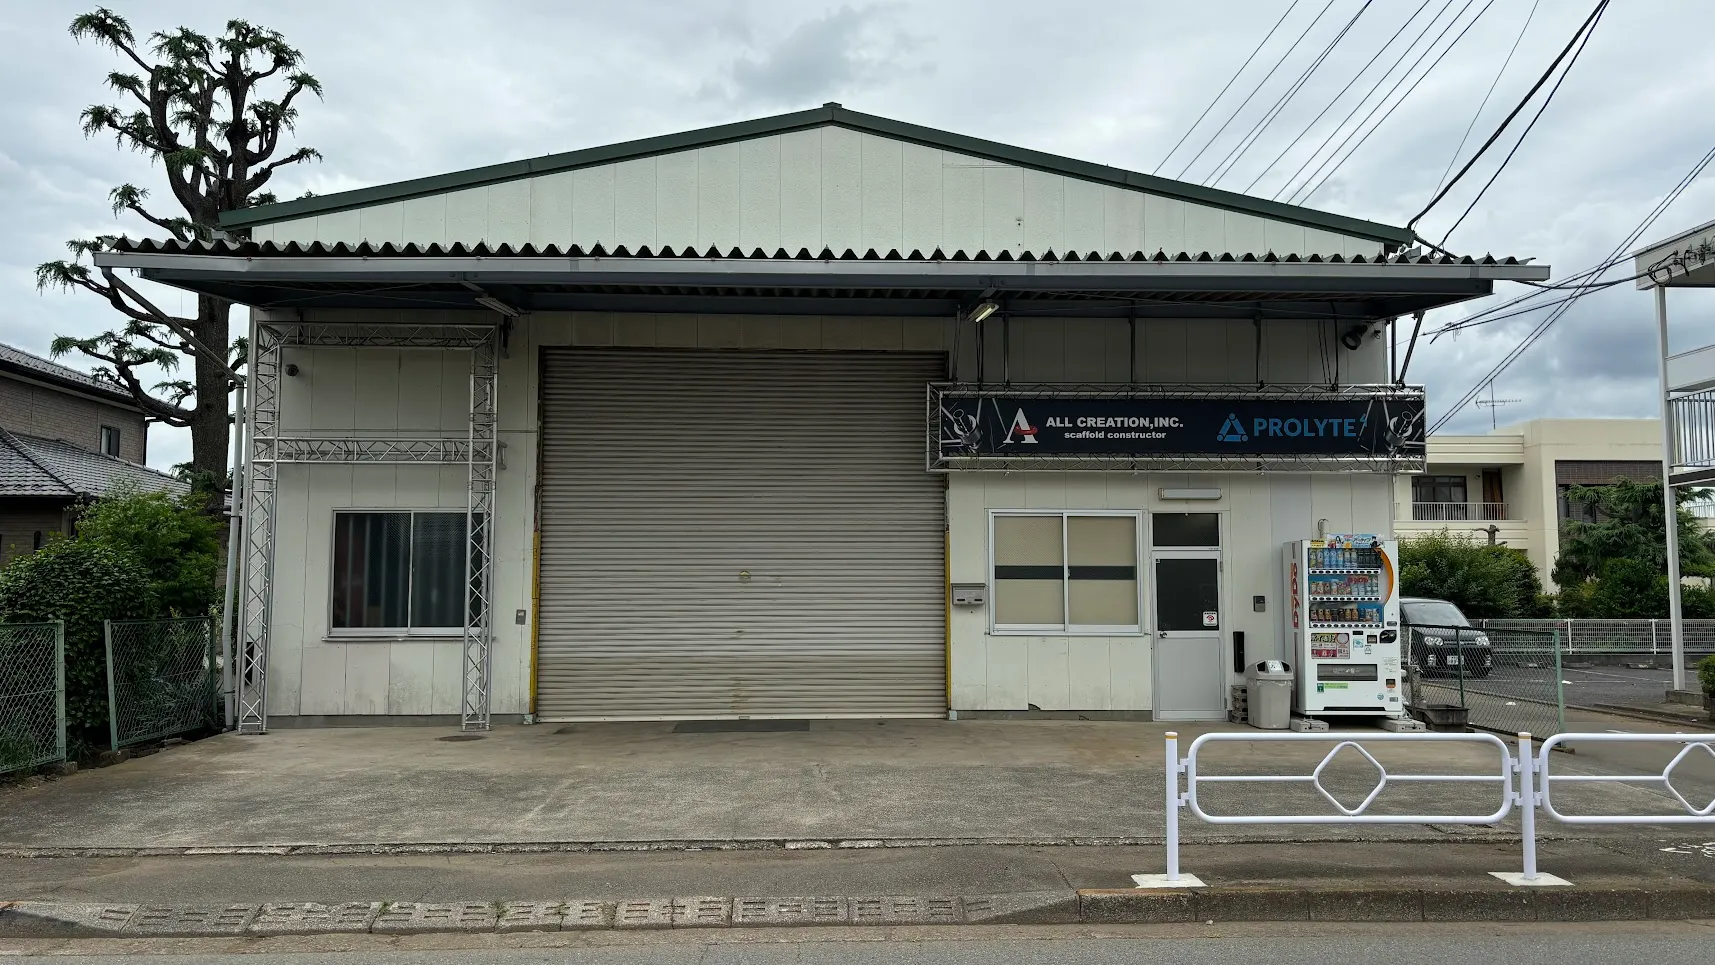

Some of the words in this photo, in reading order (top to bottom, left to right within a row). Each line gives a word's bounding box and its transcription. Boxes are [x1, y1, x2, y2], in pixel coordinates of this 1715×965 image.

[1046, 417, 1073, 428] ALL
[1077, 417, 1183, 430] CREATION,INC.
[1254, 418, 1356, 437] PROLYTE
[1064, 431, 1105, 439] scaffold
[1107, 431, 1166, 439] constructor
